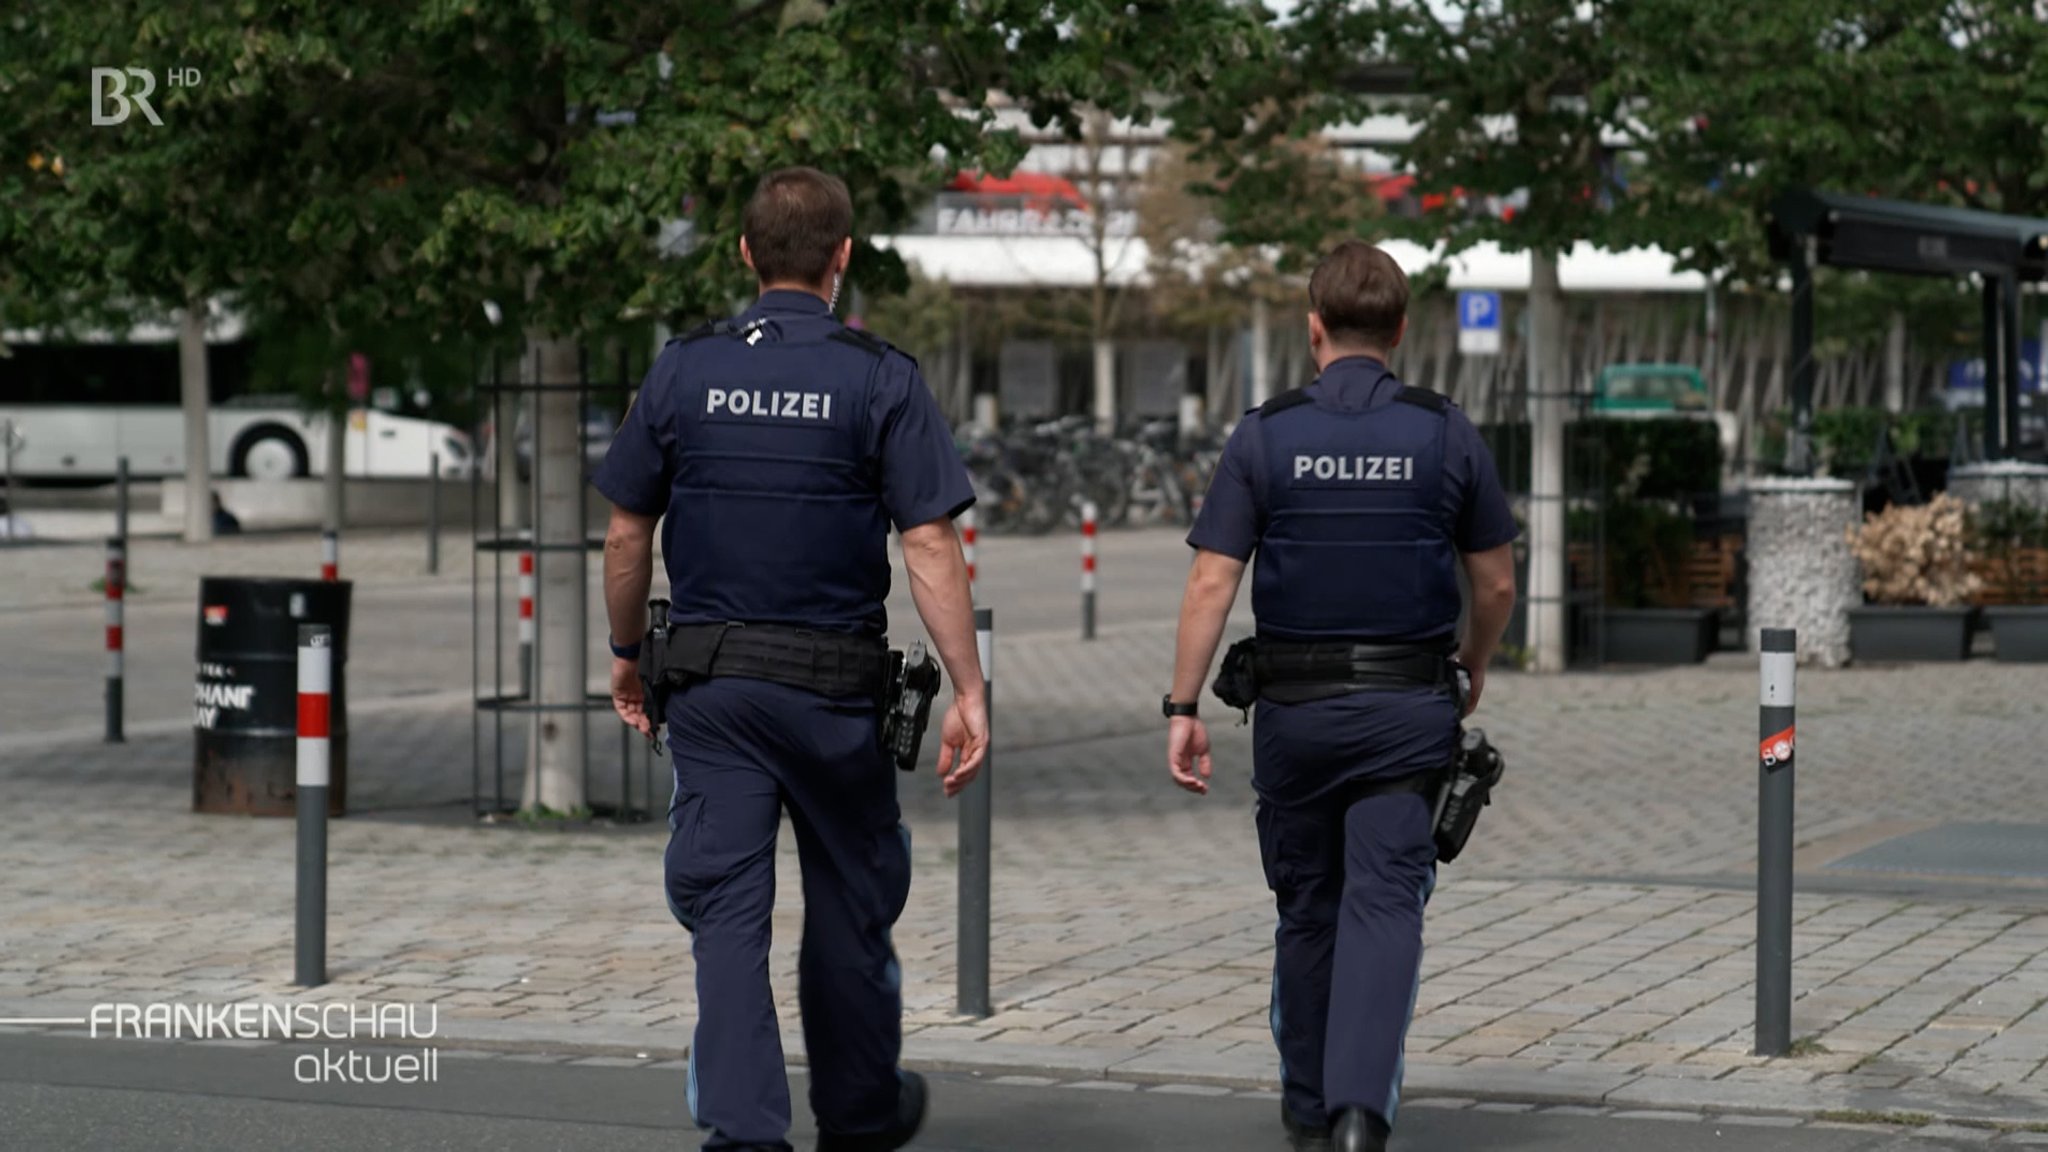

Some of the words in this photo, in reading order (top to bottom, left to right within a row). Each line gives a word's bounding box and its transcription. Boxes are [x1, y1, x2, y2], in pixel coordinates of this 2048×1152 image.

[1468, 295, 1491, 325] P
[706, 387, 831, 419] POLIZEI
[1293, 454, 1414, 480] POLIZEI
